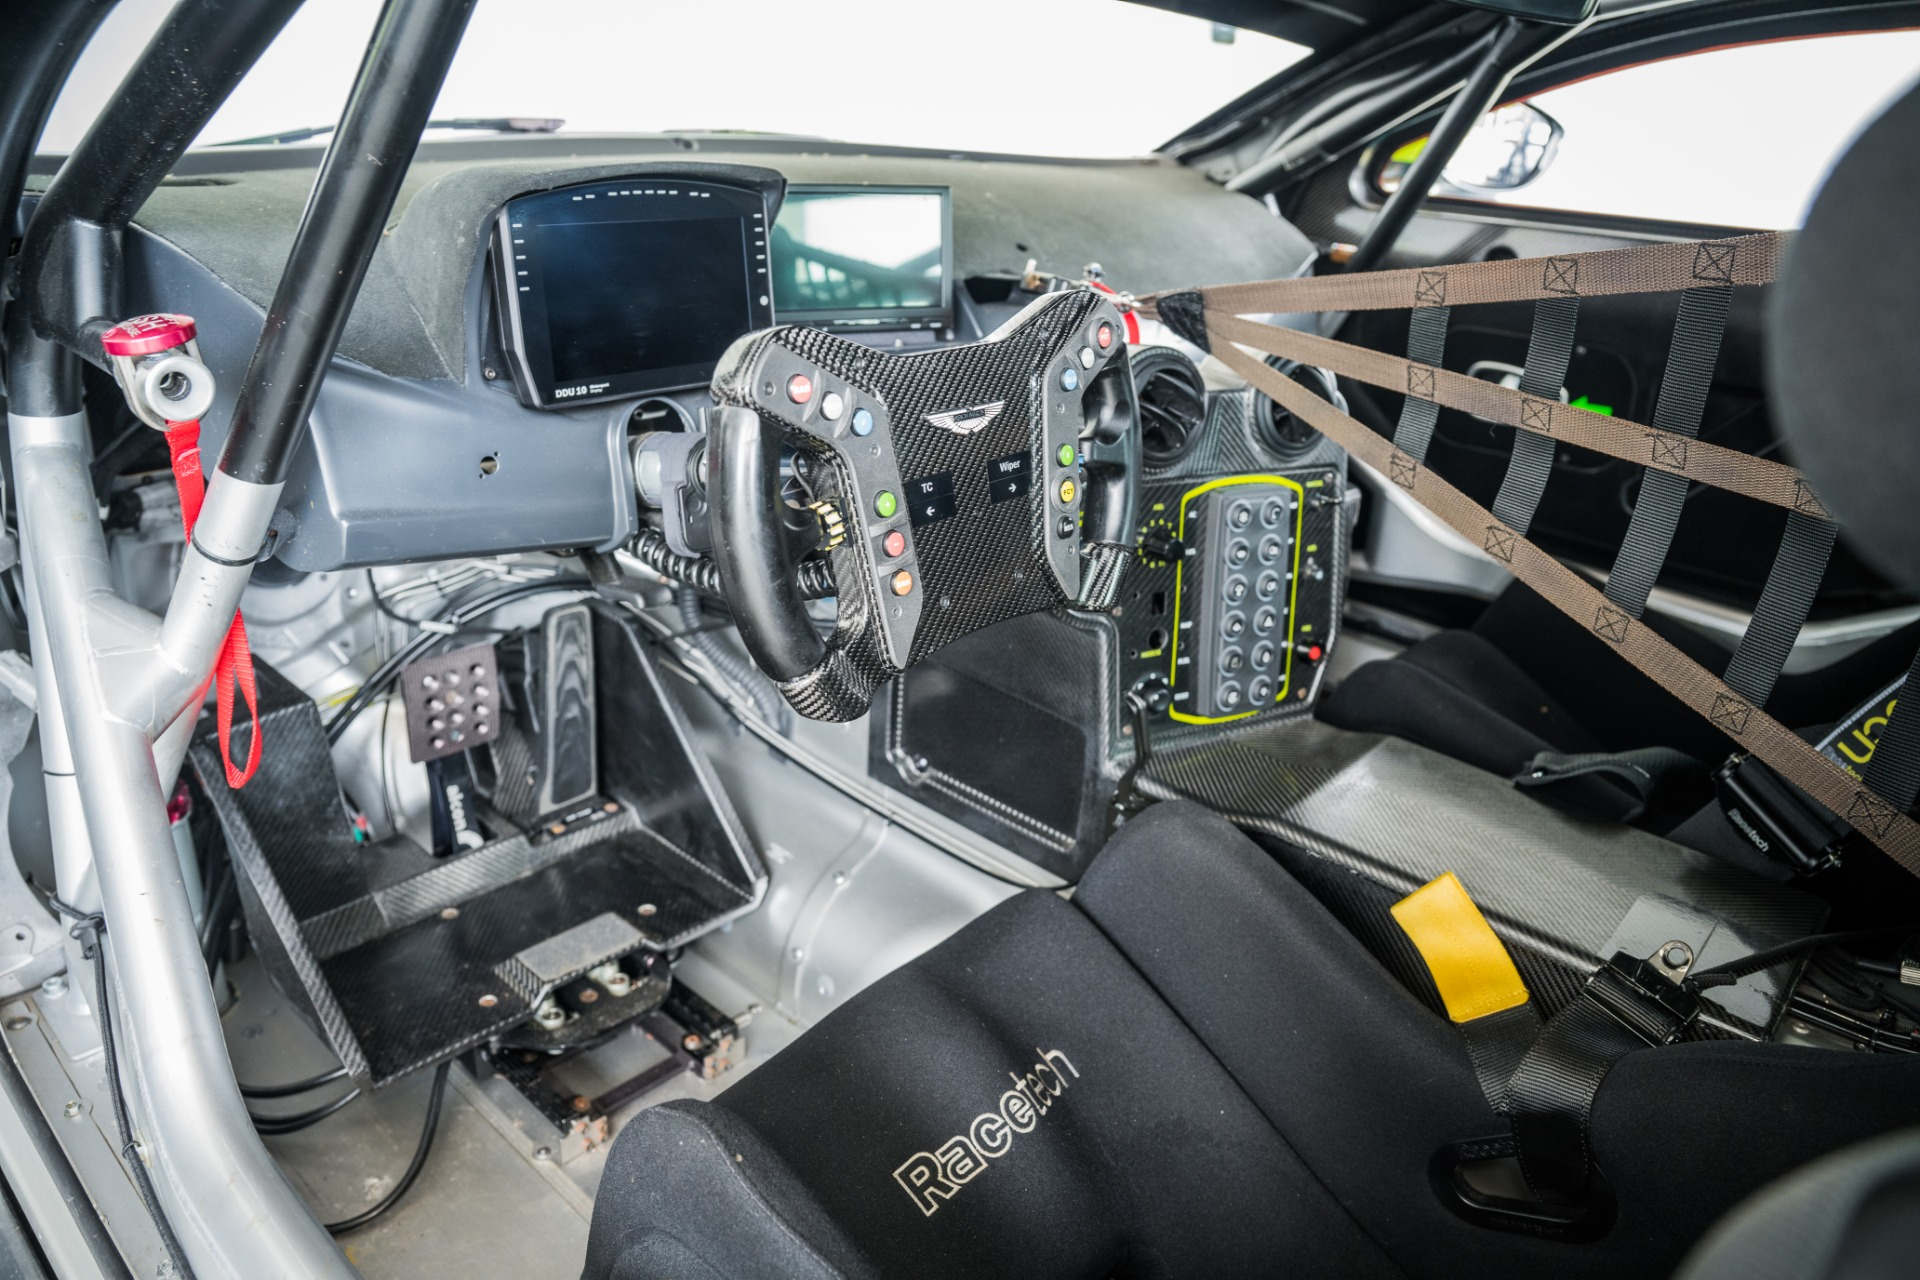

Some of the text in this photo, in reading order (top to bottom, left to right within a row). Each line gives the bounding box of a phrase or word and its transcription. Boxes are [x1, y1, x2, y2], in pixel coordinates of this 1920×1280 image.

[555, 387, 575, 398] DDU
[576, 386, 588, 396] 10
[999, 460, 1021, 472] Wiper
[921, 482, 934, 493] TC
[446, 784, 467, 831] alcon
[1728, 808, 1770, 852] Racetech
[893, 1047, 1080, 1217] Racetech
